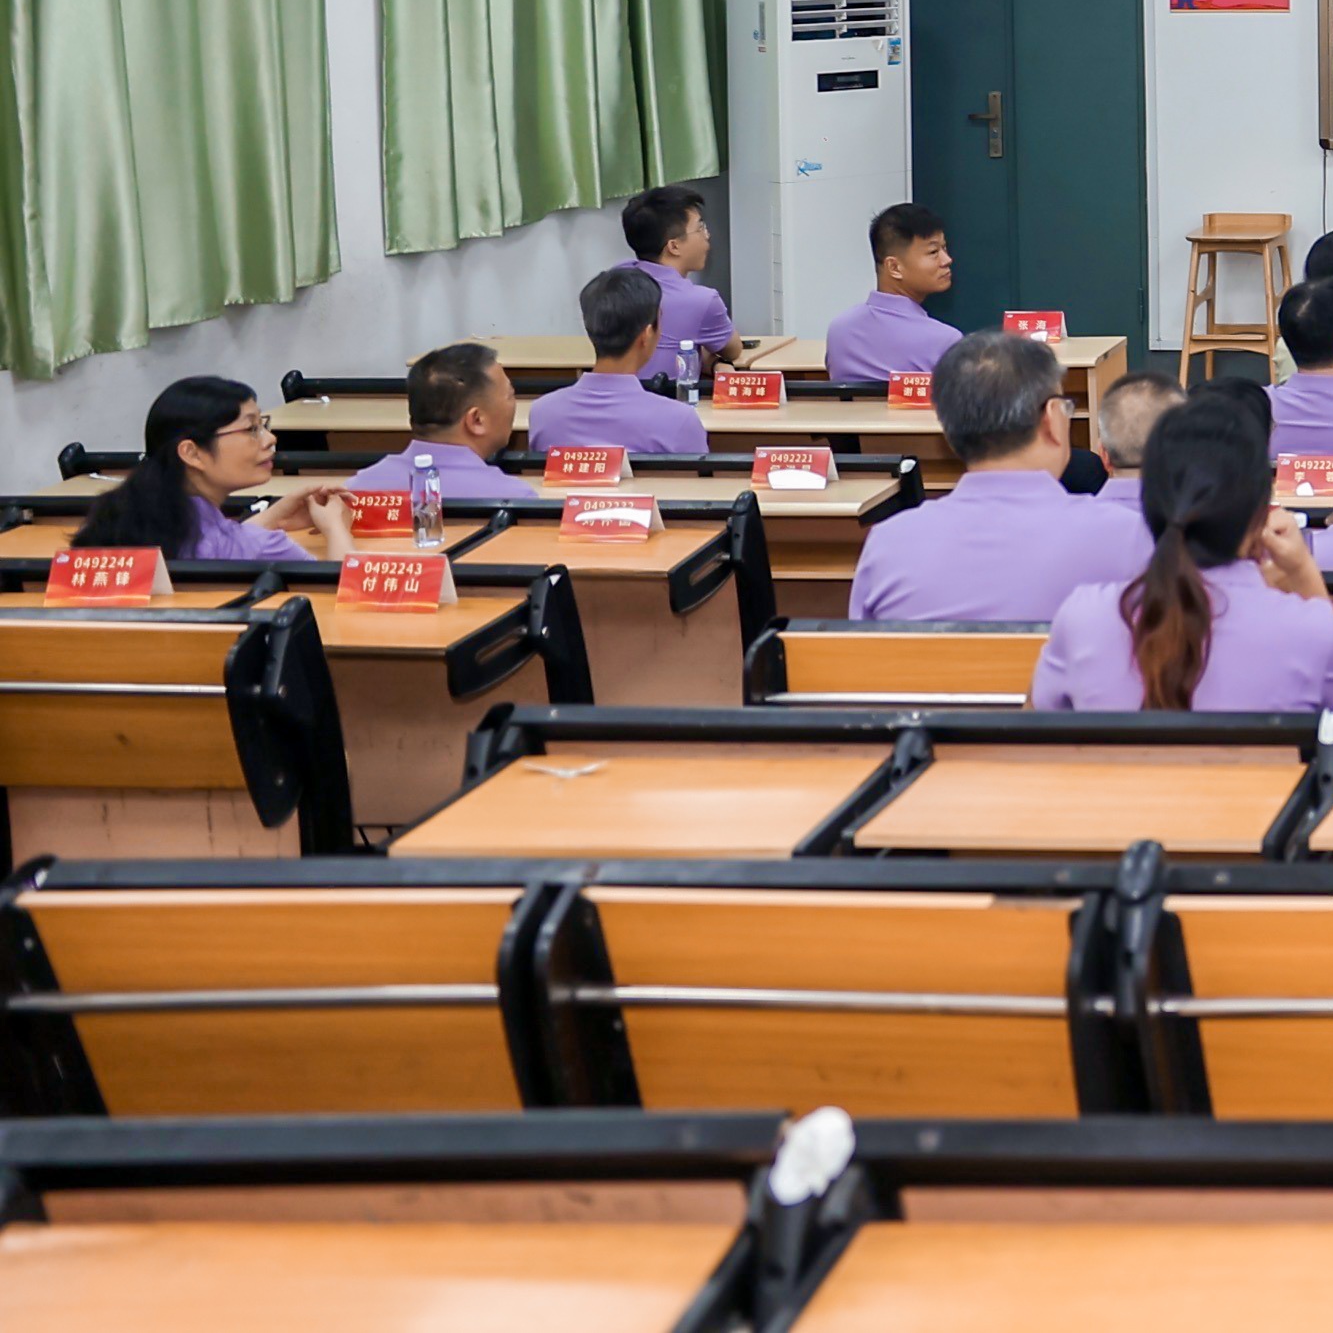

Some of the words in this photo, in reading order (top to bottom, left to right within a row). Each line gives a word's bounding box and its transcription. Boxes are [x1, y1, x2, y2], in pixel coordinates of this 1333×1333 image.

[728, 377, 767, 386] 0492211
[903, 376, 931, 385] 04922
[903, 387, 927, 397] 谢福
[563, 451, 608, 461] 0492222
[770, 453, 813, 462] 0492221
[73, 555, 134, 569] 0492244
[364, 560, 423, 575] 0492243
[362, 576, 420, 593] 付伟山
